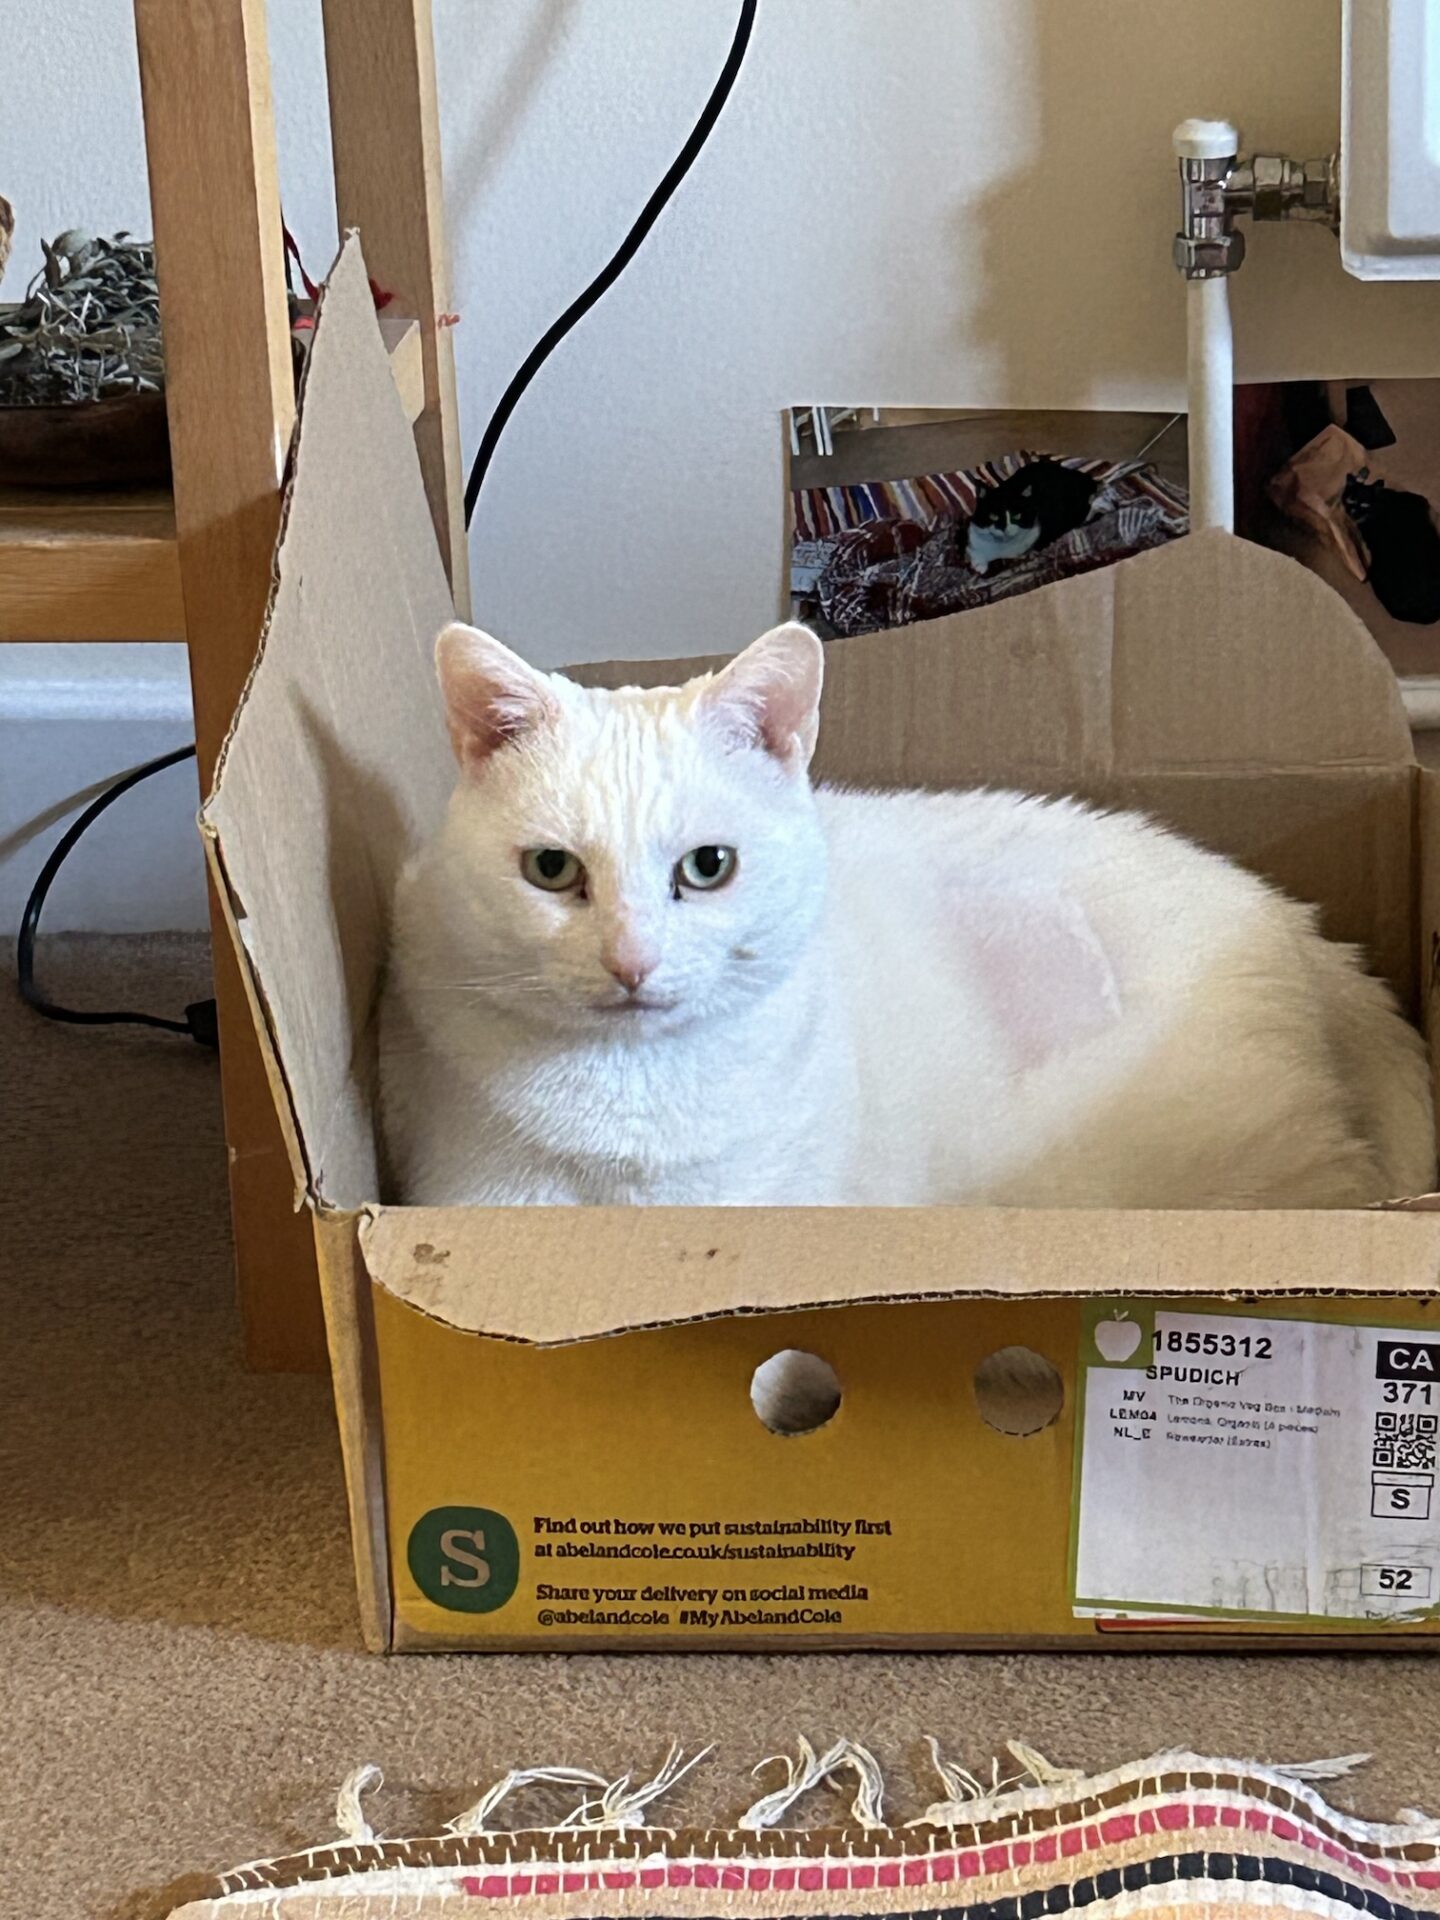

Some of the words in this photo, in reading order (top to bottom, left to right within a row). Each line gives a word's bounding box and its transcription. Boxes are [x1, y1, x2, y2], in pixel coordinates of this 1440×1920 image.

[1152, 1330, 1272, 1359] 1855312
[1389, 1348, 1434, 1371] CA
[1146, 1365, 1240, 1386] SPUDICH
[1383, 1382, 1431, 1405] 371
[1391, 1488, 1410, 1509] S
[534, 1517, 577, 1534] Find
[580, 1519, 611, 1534] out
[614, 1519, 655, 1535] how
[659, 1523, 686, 1535] we
[690, 1520, 721, 1538] put
[724, 1519, 852, 1537] sustainability
[855, 1519, 892, 1535] first
[441, 1529, 490, 1587] S
[535, 1543, 552, 1557] at
[1379, 1568, 1412, 1590] 52
[536, 1584, 589, 1600] Share
[593, 1589, 637, 1603] your
[641, 1586, 718, 1604] delivery
[722, 1589, 747, 1601] on
[750, 1585, 804, 1600] social
[808, 1584, 868, 1600] media
[538, 1609, 669, 1626] @abelandcole
